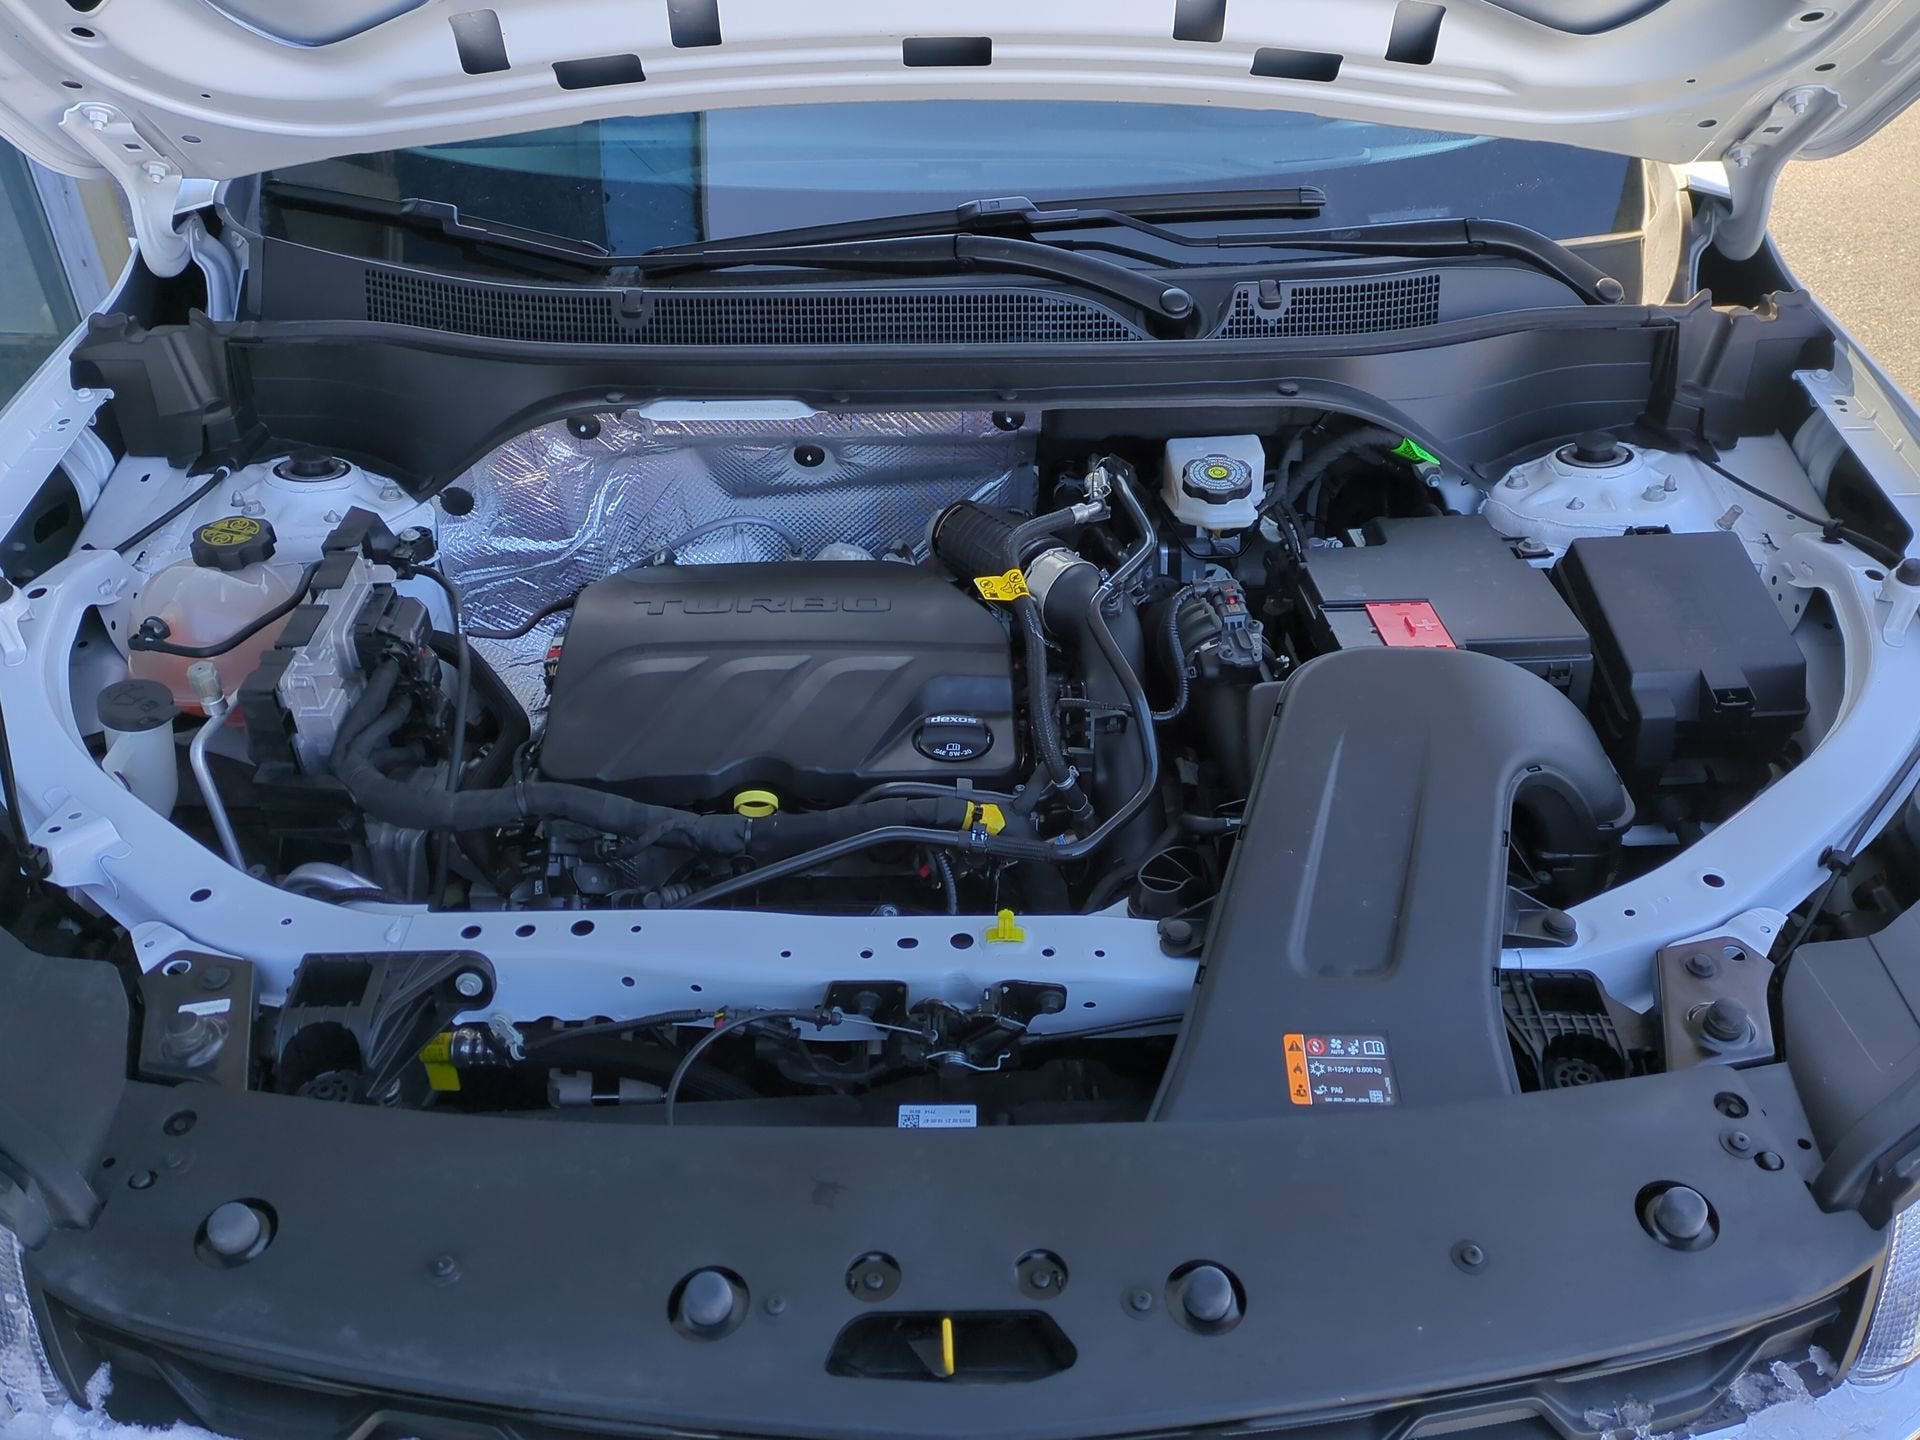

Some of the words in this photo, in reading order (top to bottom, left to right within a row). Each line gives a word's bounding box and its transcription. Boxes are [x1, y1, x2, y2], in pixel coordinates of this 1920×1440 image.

[633, 596, 892, 616] TURBO
[930, 715, 977, 724] dexos
[933, 748, 947, 756] SAE
[948, 748, 973, 757] 5W-30
[1373, 1067, 1382, 1075] kg
[1330, 1086, 1344, 1094] PAG
